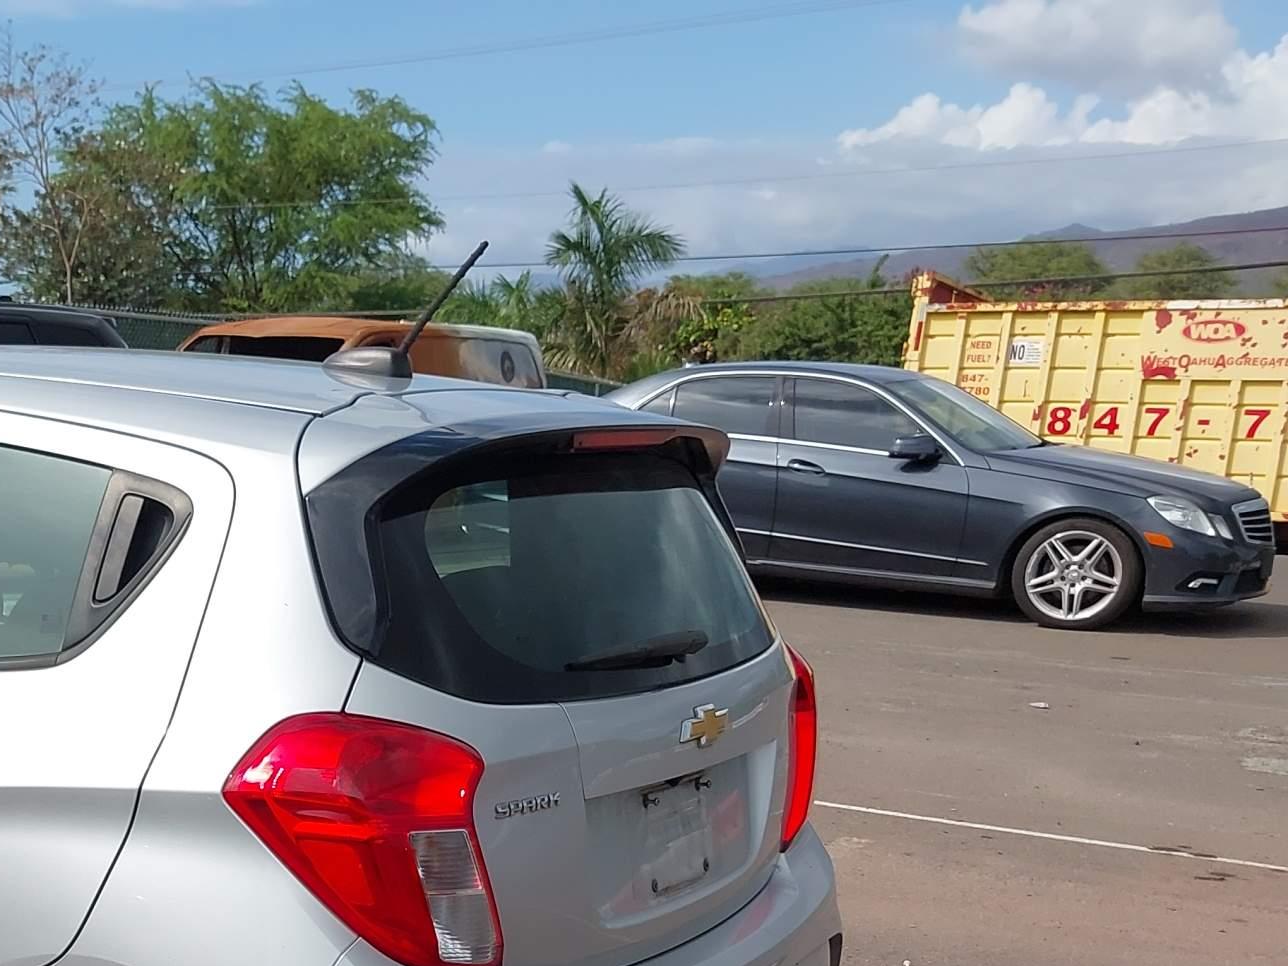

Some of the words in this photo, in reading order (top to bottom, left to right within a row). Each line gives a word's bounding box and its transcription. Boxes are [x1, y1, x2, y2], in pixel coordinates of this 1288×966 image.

[1189, 323, 1237, 340] WOA
[970, 341, 992, 350] NEED
[1009, 344, 1026, 361] NO
[966, 354, 992, 363] FUEL?
[1178, 354, 1216, 369] OAHU
[494, 792, 561, 820] SPARK
